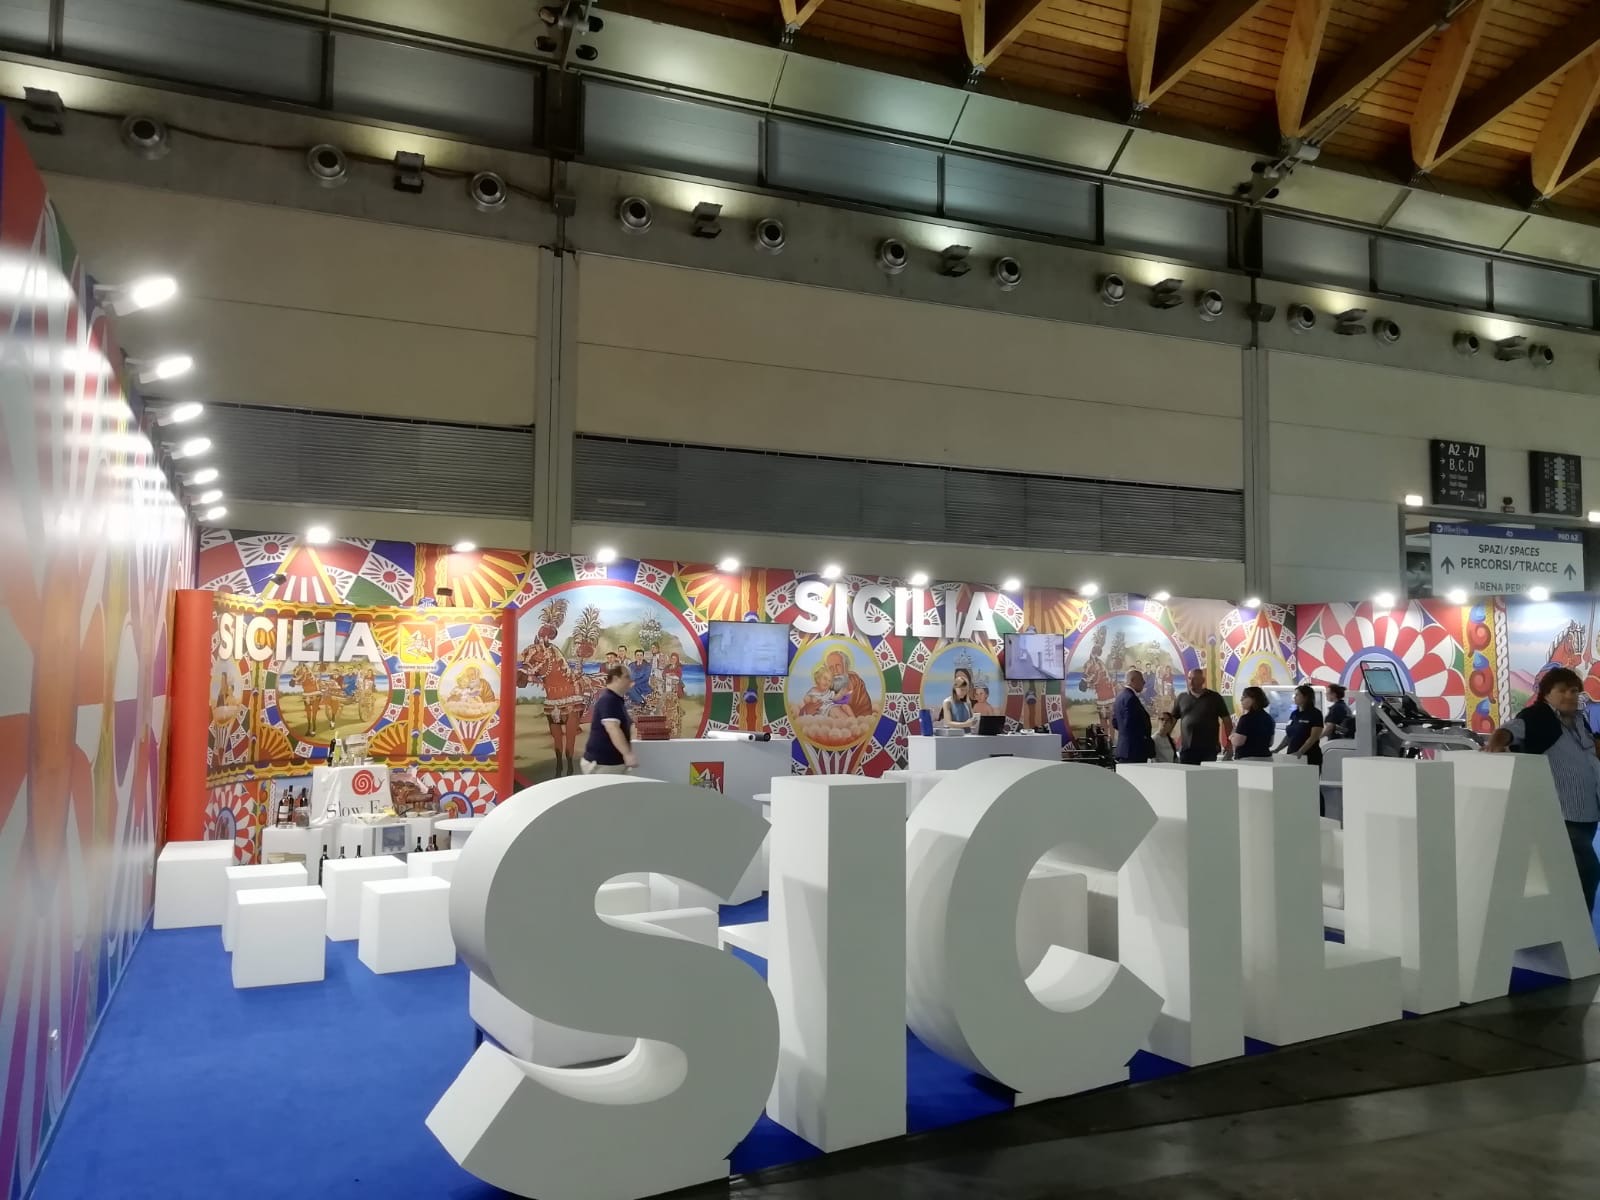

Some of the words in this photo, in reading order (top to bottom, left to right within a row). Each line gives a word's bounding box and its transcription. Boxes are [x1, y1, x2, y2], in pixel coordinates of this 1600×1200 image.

[1448, 443, 1460, 456] A2
[1468, 445, 1480, 458] A7
[1478, 543, 1540, 557] SPAZI/SPACES
[1460, 557, 1558, 574] PERCORSI/TRACCE
[1474, 581, 1503, 593] ARENA
[792, 581, 1001, 639] SICILIA
[218, 612, 382, 663] SICILIA
[326, 800, 362, 819] Slow
[425, 754, 1600, 1200] SICILIA
